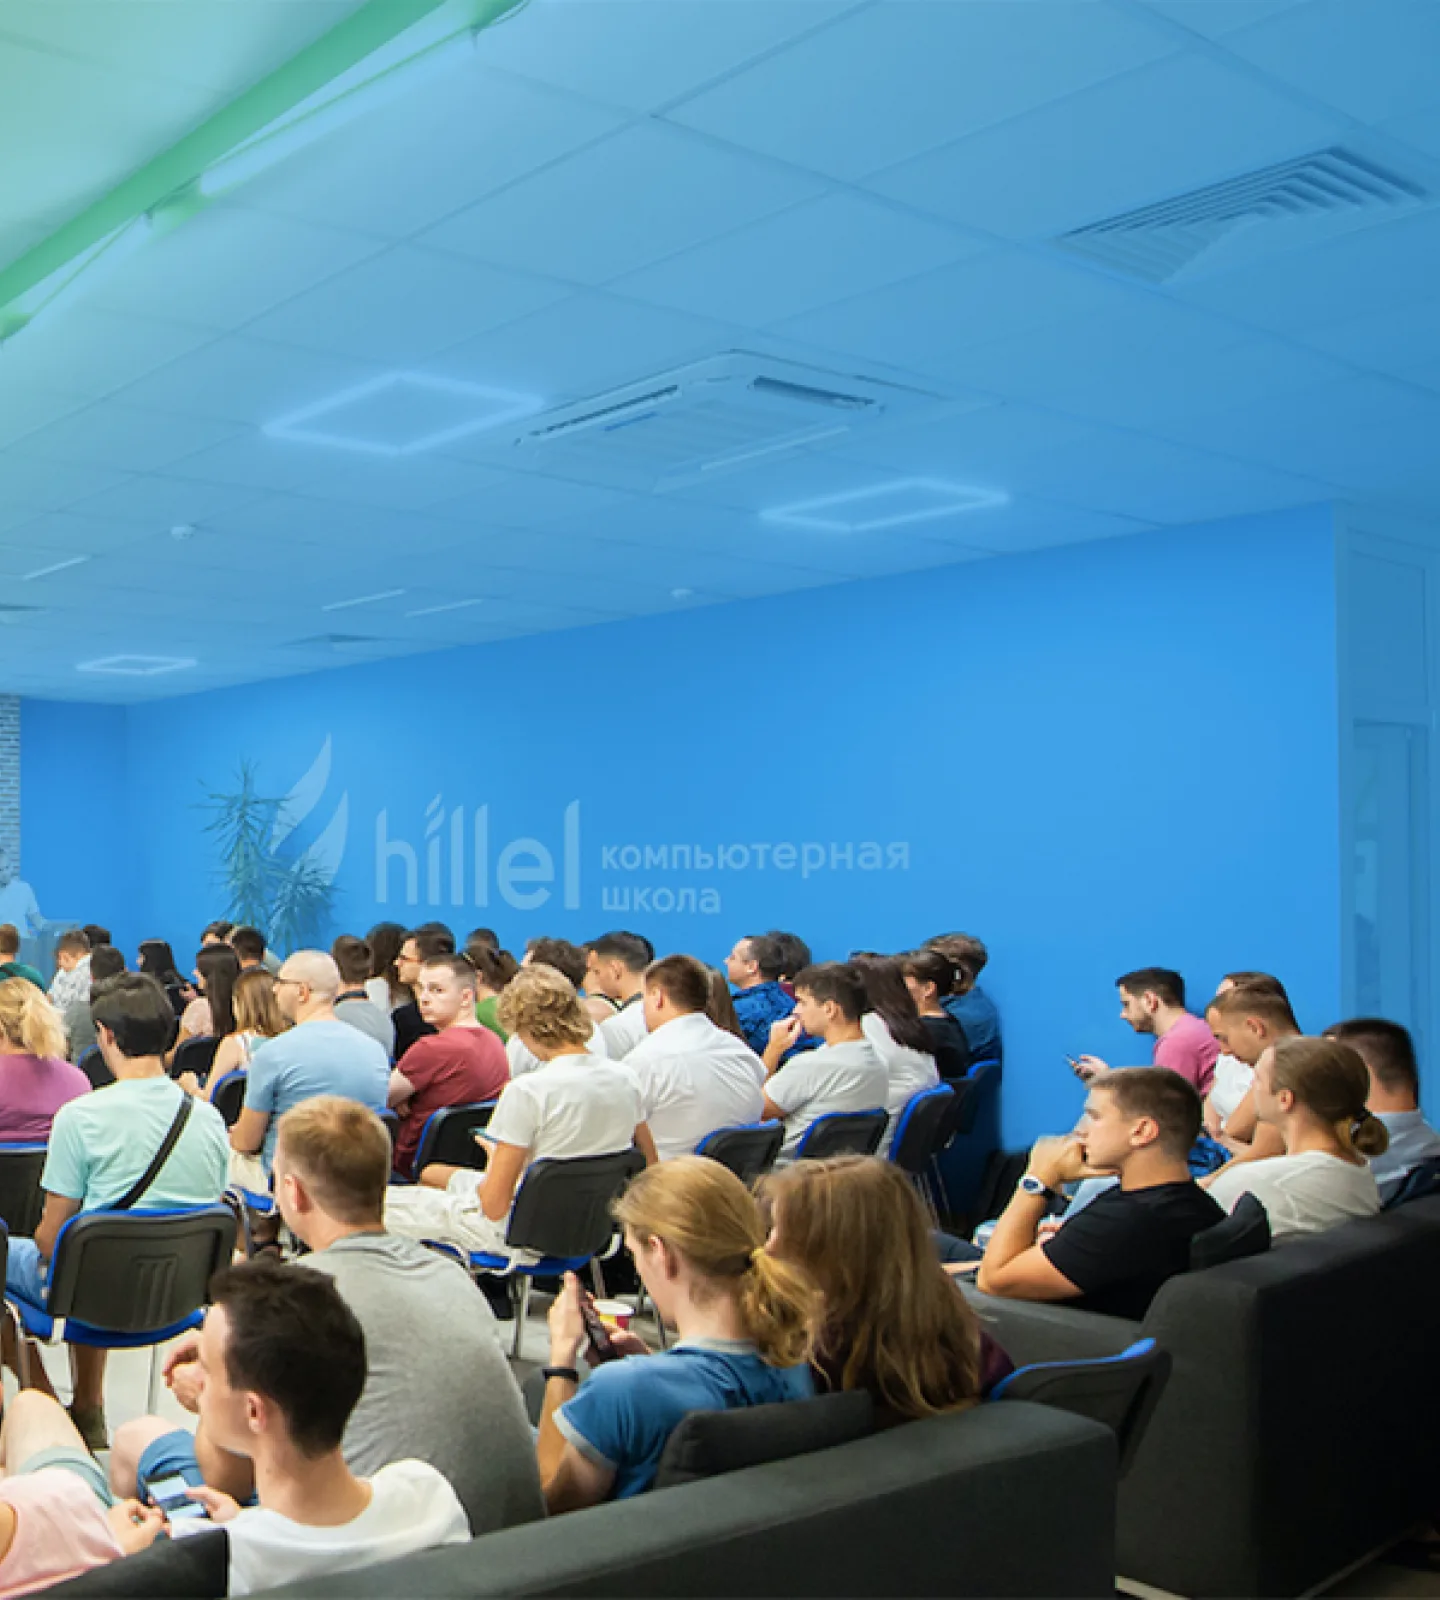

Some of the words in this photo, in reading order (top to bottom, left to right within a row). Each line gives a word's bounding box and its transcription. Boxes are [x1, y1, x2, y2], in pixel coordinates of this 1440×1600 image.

[375, 792, 580, 910] hillel
[602, 842, 909, 878] компьютерная
[602, 885, 721, 914] школа
